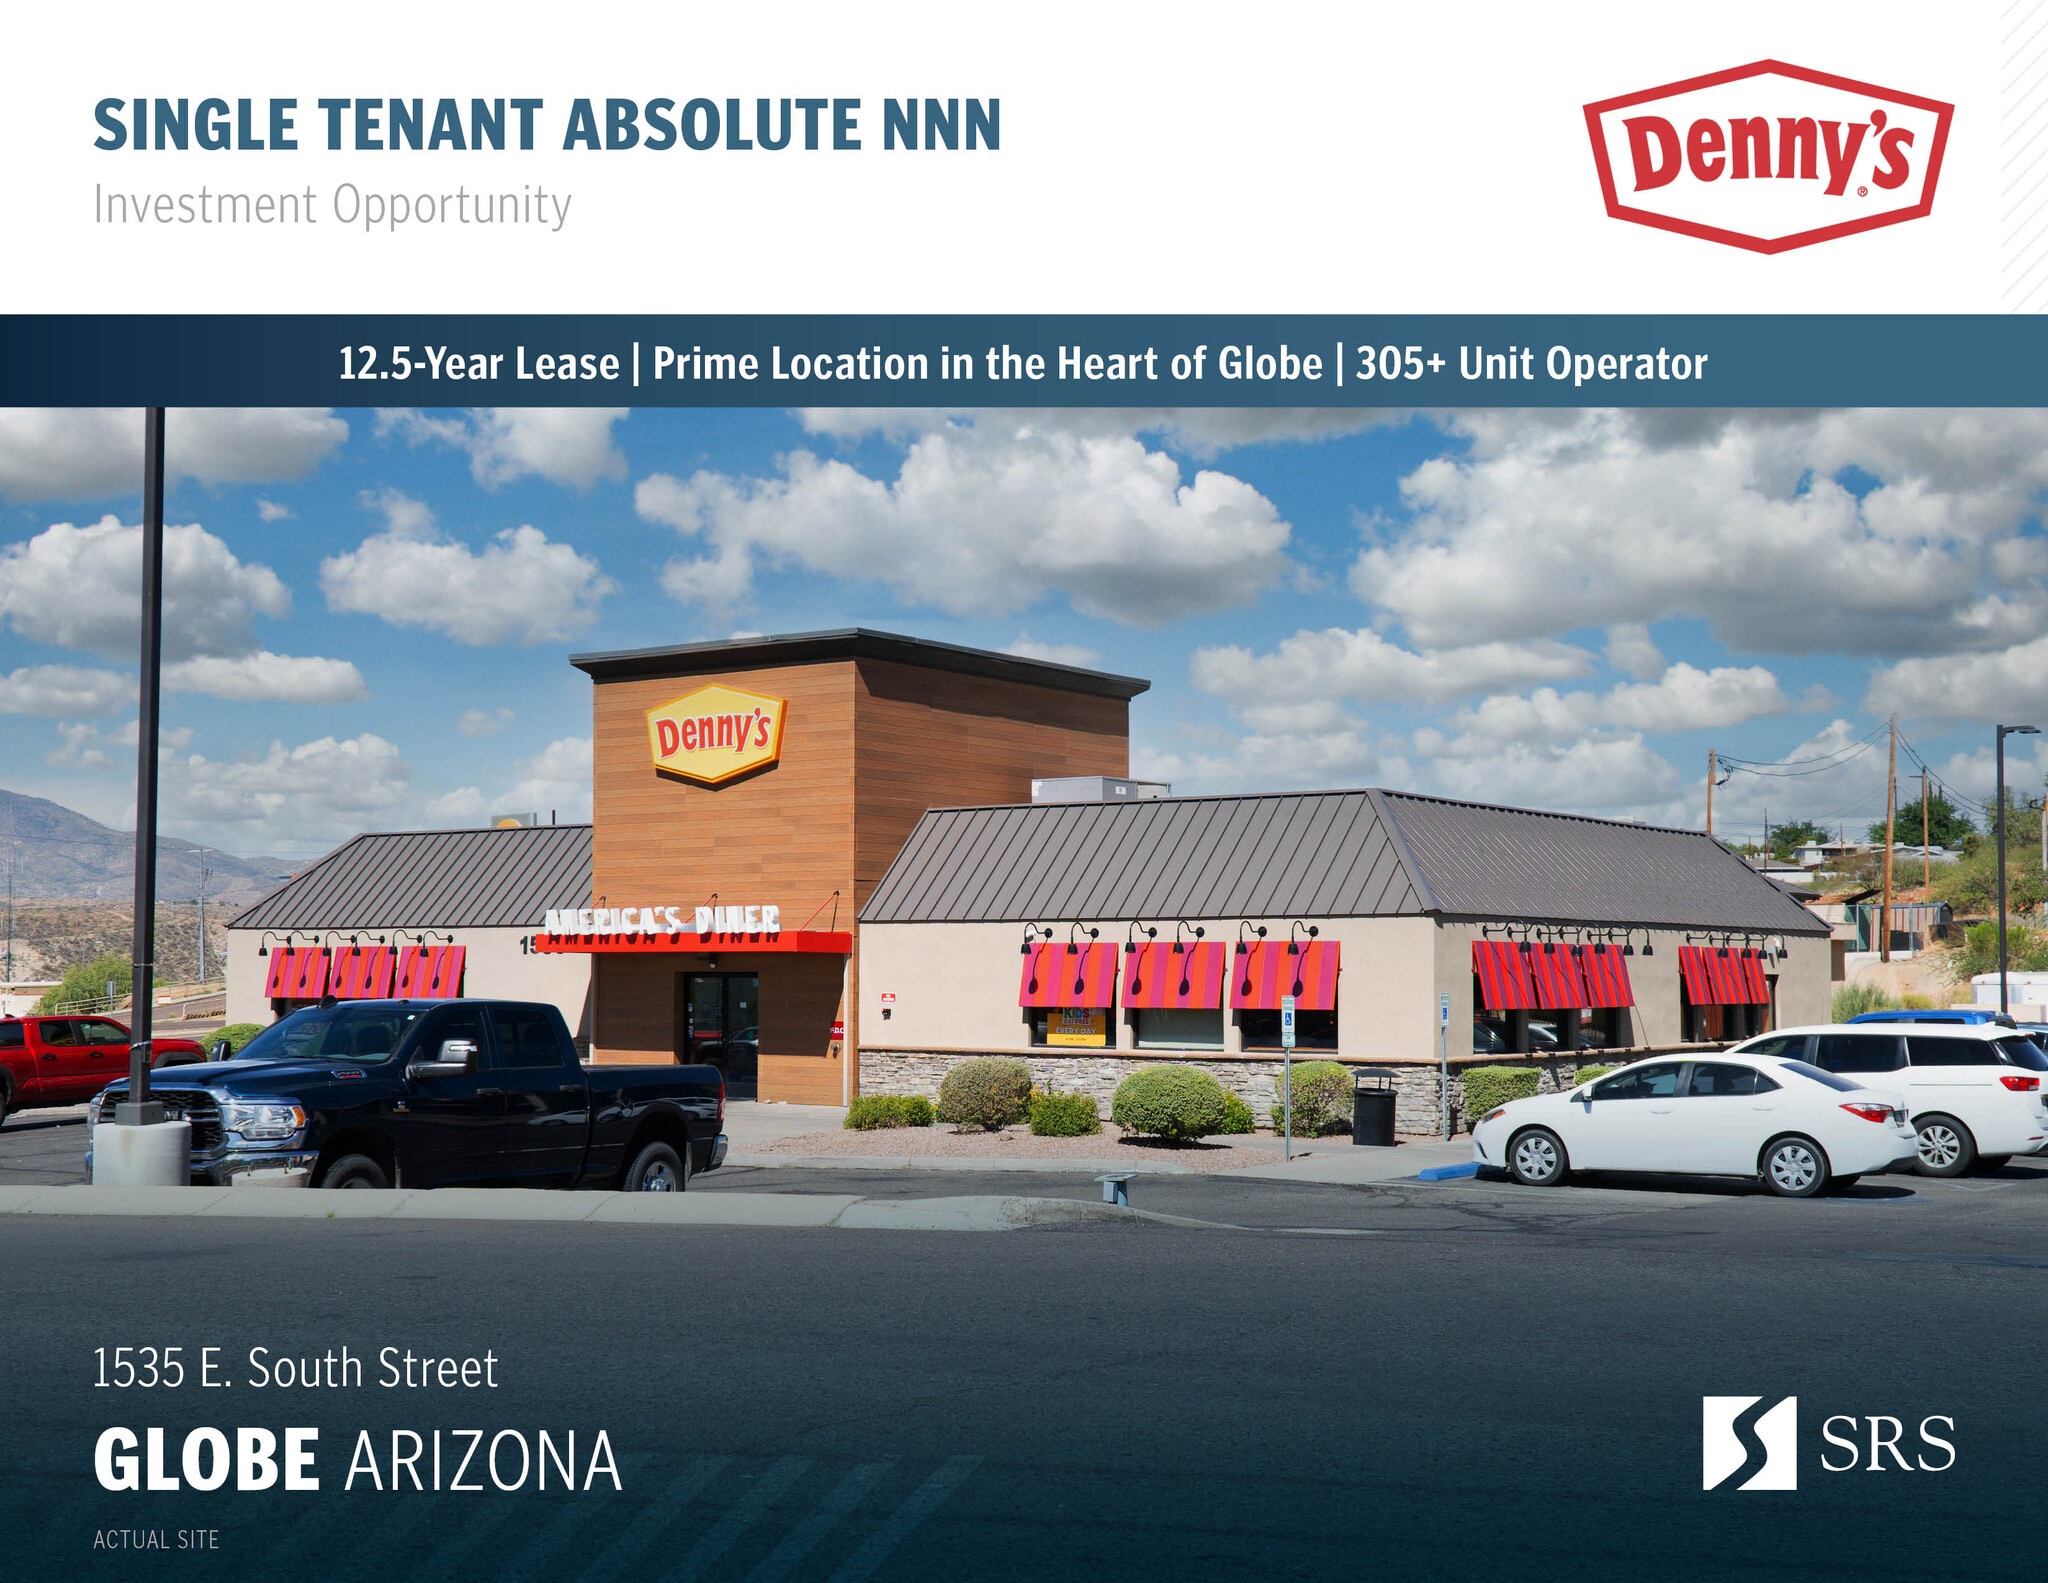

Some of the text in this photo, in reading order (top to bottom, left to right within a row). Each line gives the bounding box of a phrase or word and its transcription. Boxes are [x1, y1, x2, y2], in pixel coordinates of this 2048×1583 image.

[654, 705, 773, 760] Denny's
[544, 905, 782, 936] AMERICA'S DINER
